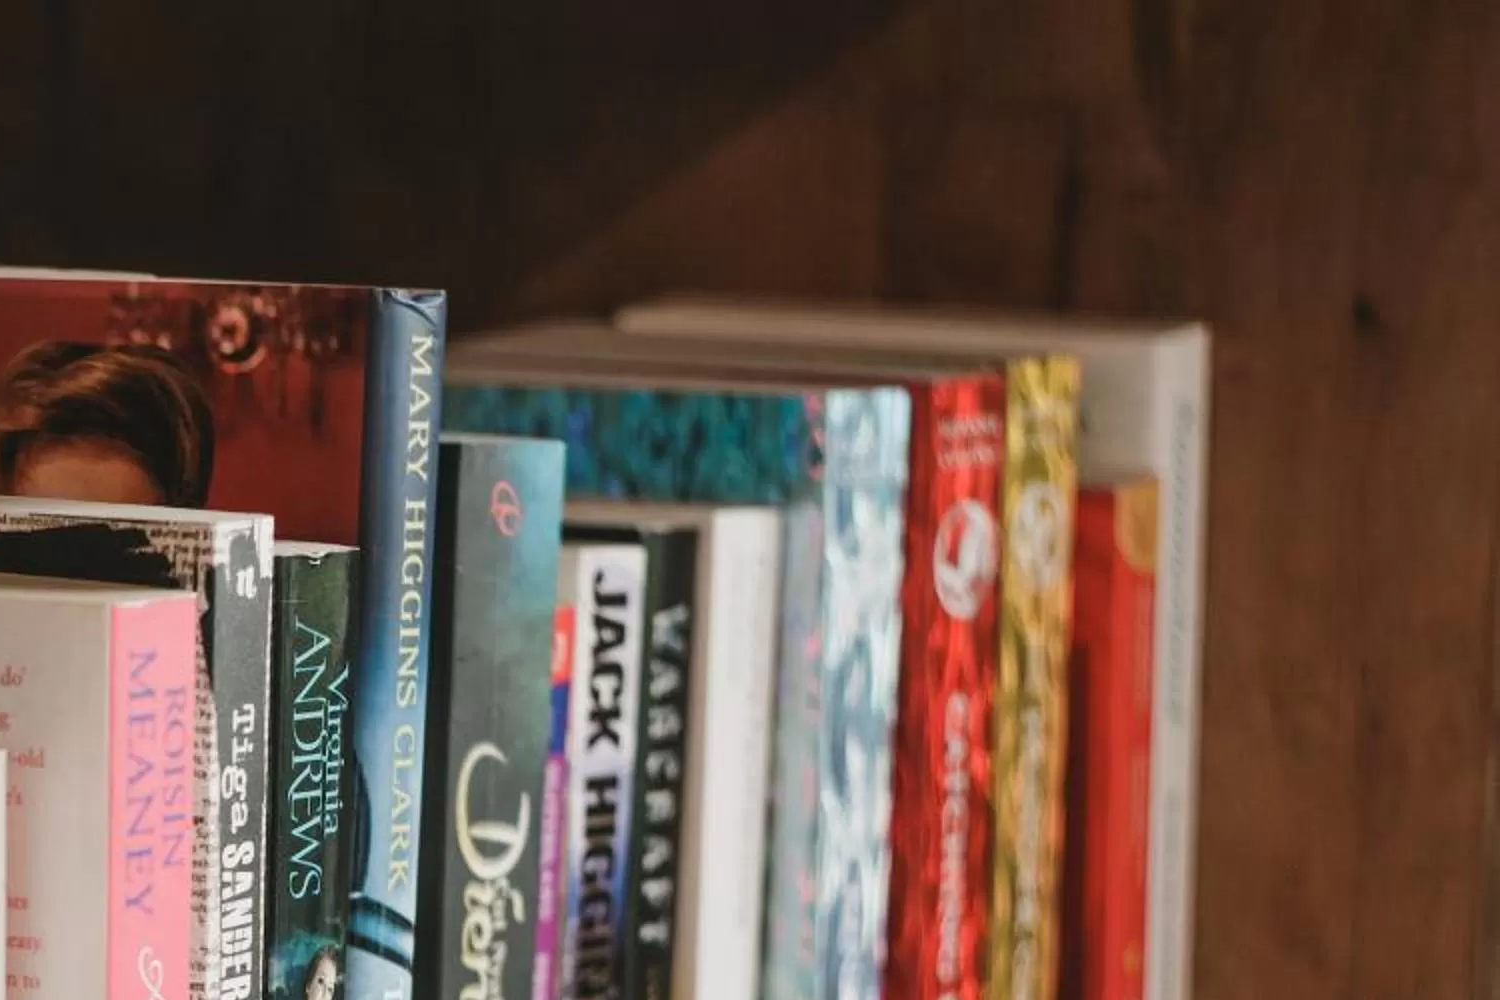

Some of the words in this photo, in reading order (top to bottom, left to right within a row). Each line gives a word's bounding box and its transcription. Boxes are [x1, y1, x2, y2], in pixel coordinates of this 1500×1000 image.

[405, 334, 436, 483] MARY
[395, 498, 428, 709] HIGGINS
[585, 568, 629, 749] JACK
[124, 650, 158, 918] MEANEY
[162, 684, 188, 868] ROISIN
[219, 703, 255, 832] Tiga
[287, 618, 332, 899] ANDREWS
[322, 663, 351, 836] Virginia
[388, 723, 415, 892] CLARK
